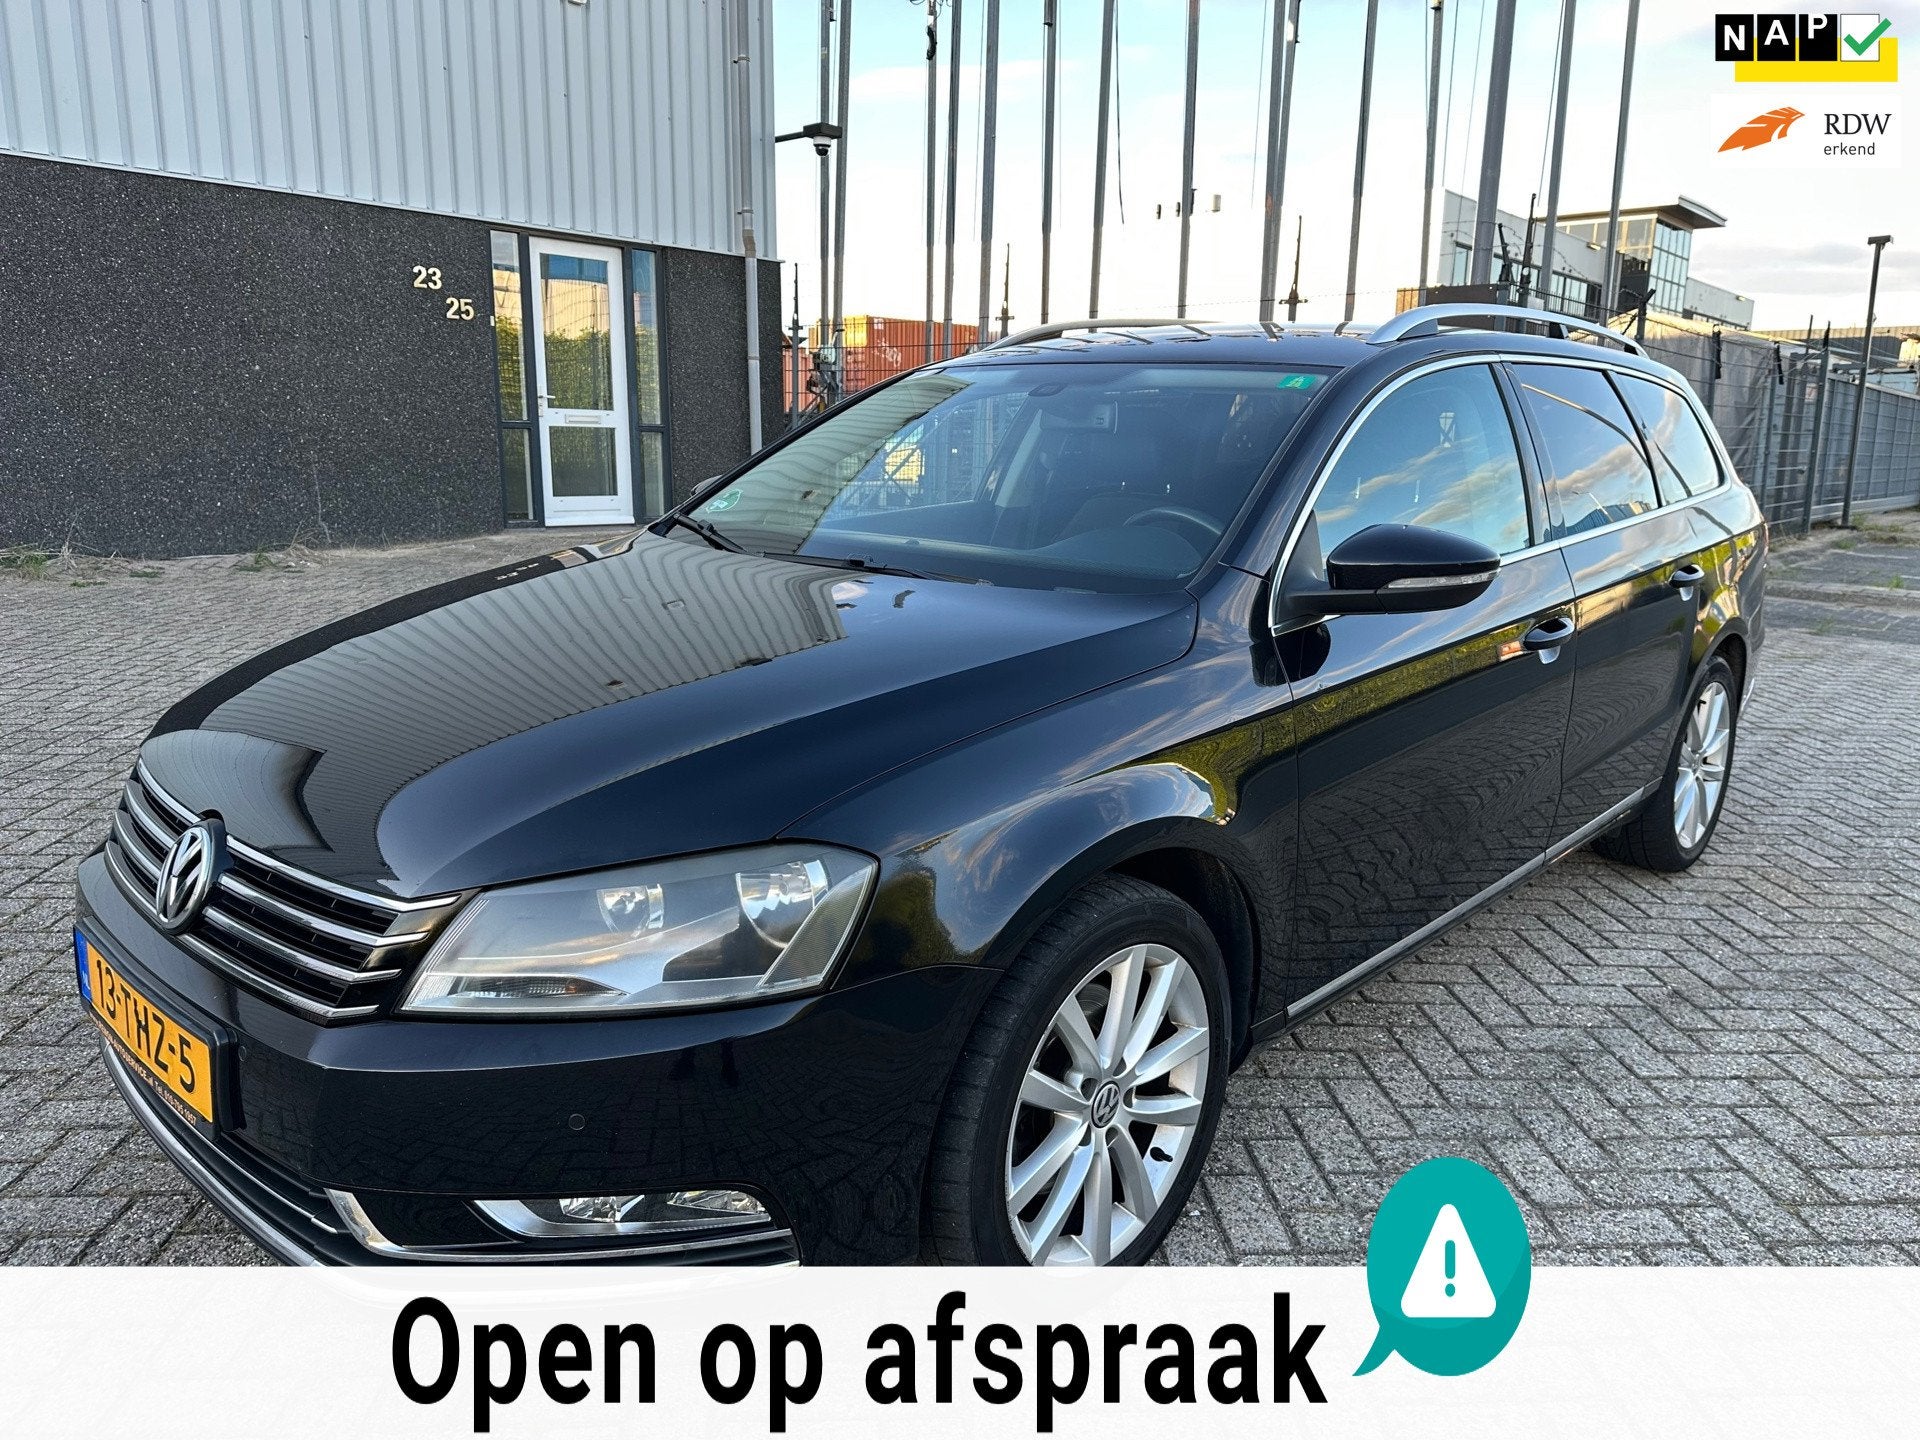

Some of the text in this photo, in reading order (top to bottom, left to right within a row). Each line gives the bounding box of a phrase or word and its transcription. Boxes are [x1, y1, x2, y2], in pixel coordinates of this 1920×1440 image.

[412, 265, 442, 290] 23
[445, 297, 475, 321] 25
[96, 959, 196, 1094] 13-THZ-5
